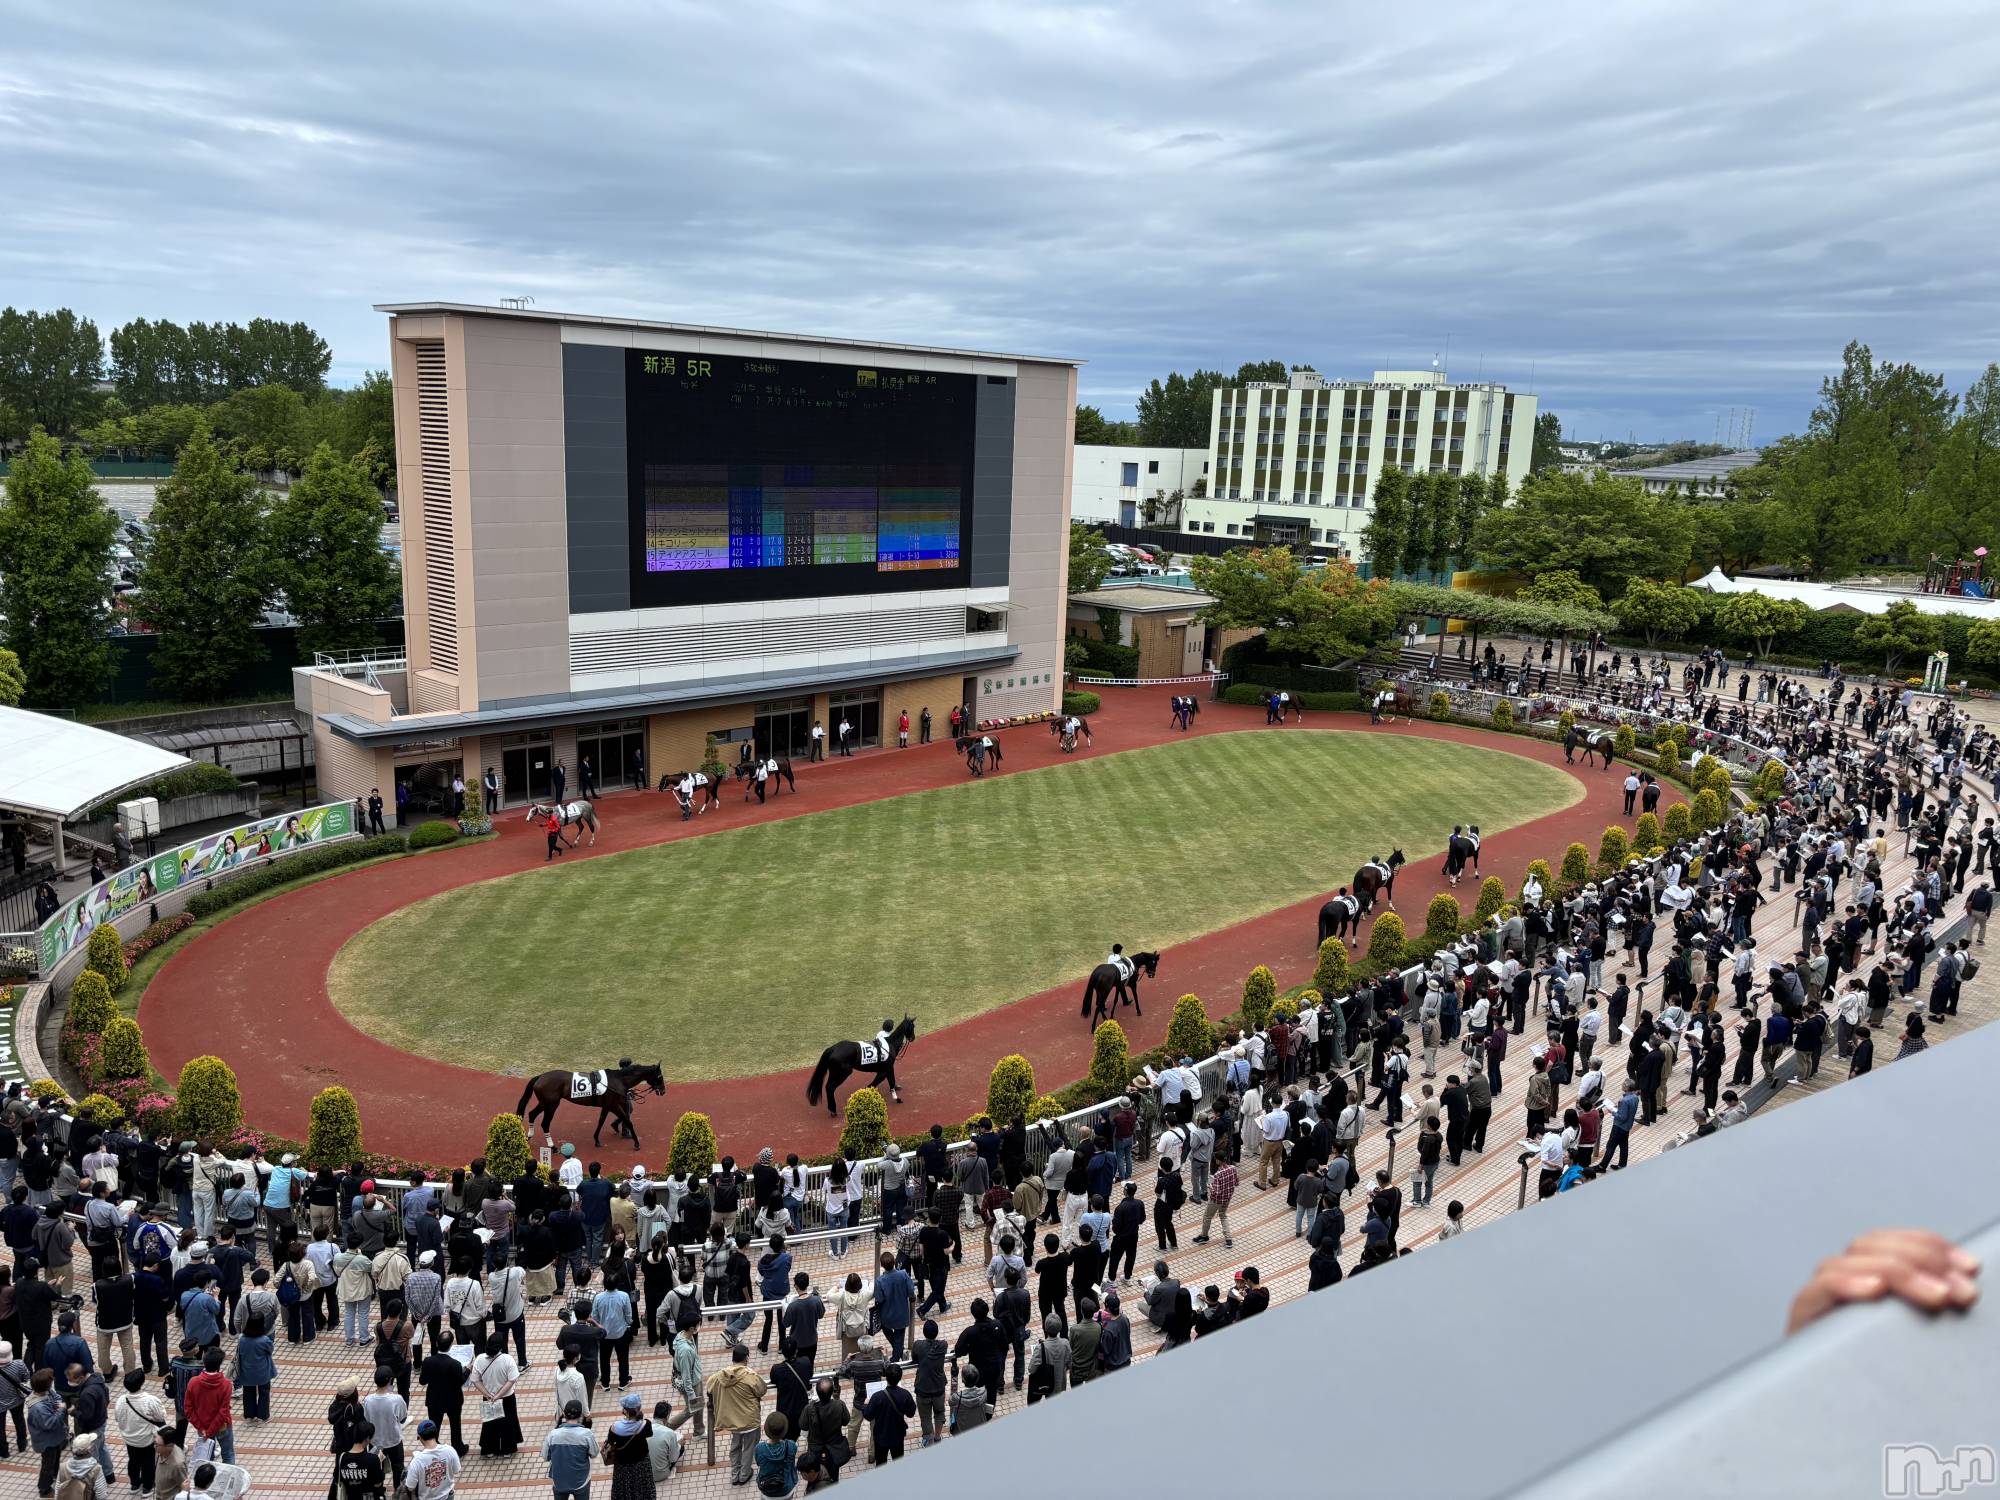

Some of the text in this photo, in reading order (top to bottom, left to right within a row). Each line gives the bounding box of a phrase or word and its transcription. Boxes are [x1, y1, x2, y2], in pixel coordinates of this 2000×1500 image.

[644, 356, 712, 377] 新潟 5R
[658, 560, 712, 570] アースアクシス
[862, 1046, 874, 1059] 15
[573, 1078, 587, 1093] 16
